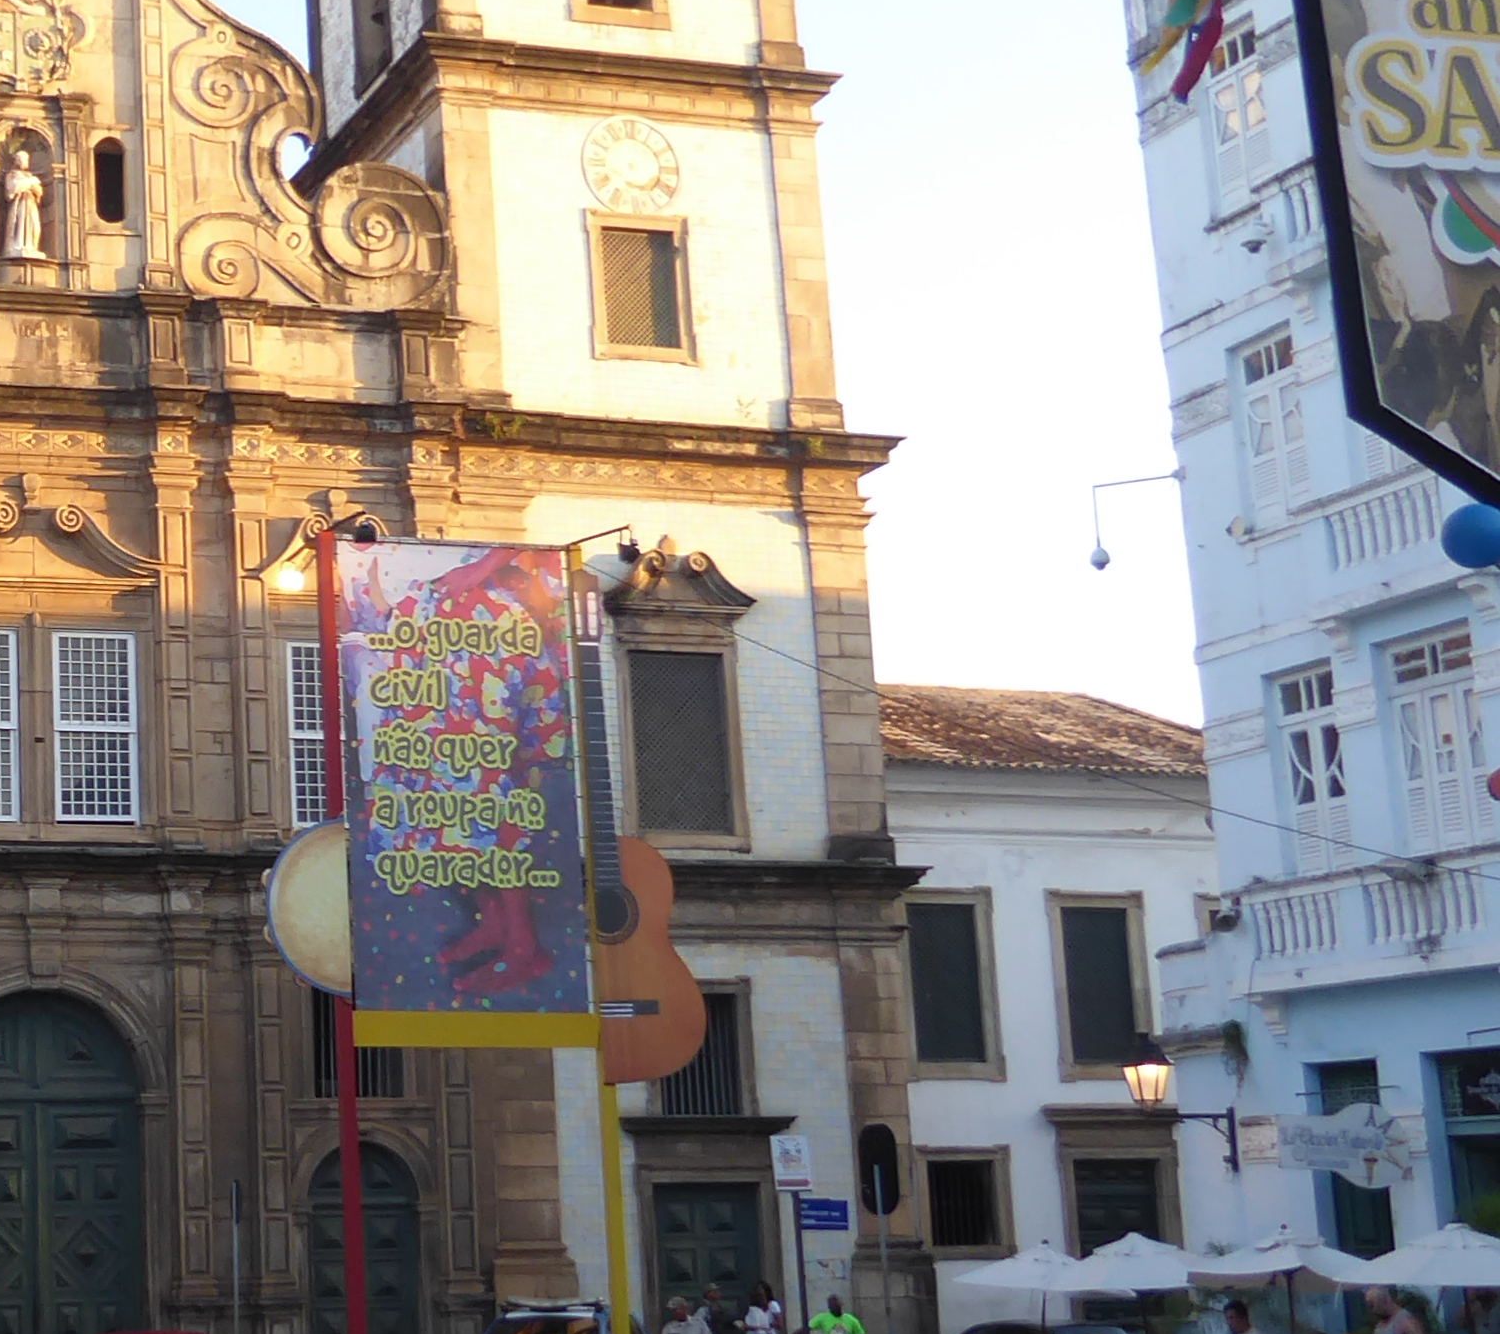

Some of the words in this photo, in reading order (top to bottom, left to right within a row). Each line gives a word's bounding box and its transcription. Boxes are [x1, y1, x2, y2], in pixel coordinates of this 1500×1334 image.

[1359, 45, 1500, 153] SA
[424, 618, 540, 657] guarda
[369, 668, 444, 707] civil
[372, 721, 429, 766] não
[436, 733, 515, 775] quer
[374, 793, 397, 826] a
[404, 793, 499, 836] roupa
[507, 791, 544, 828] no
[374, 847, 561, 894] quarador...
